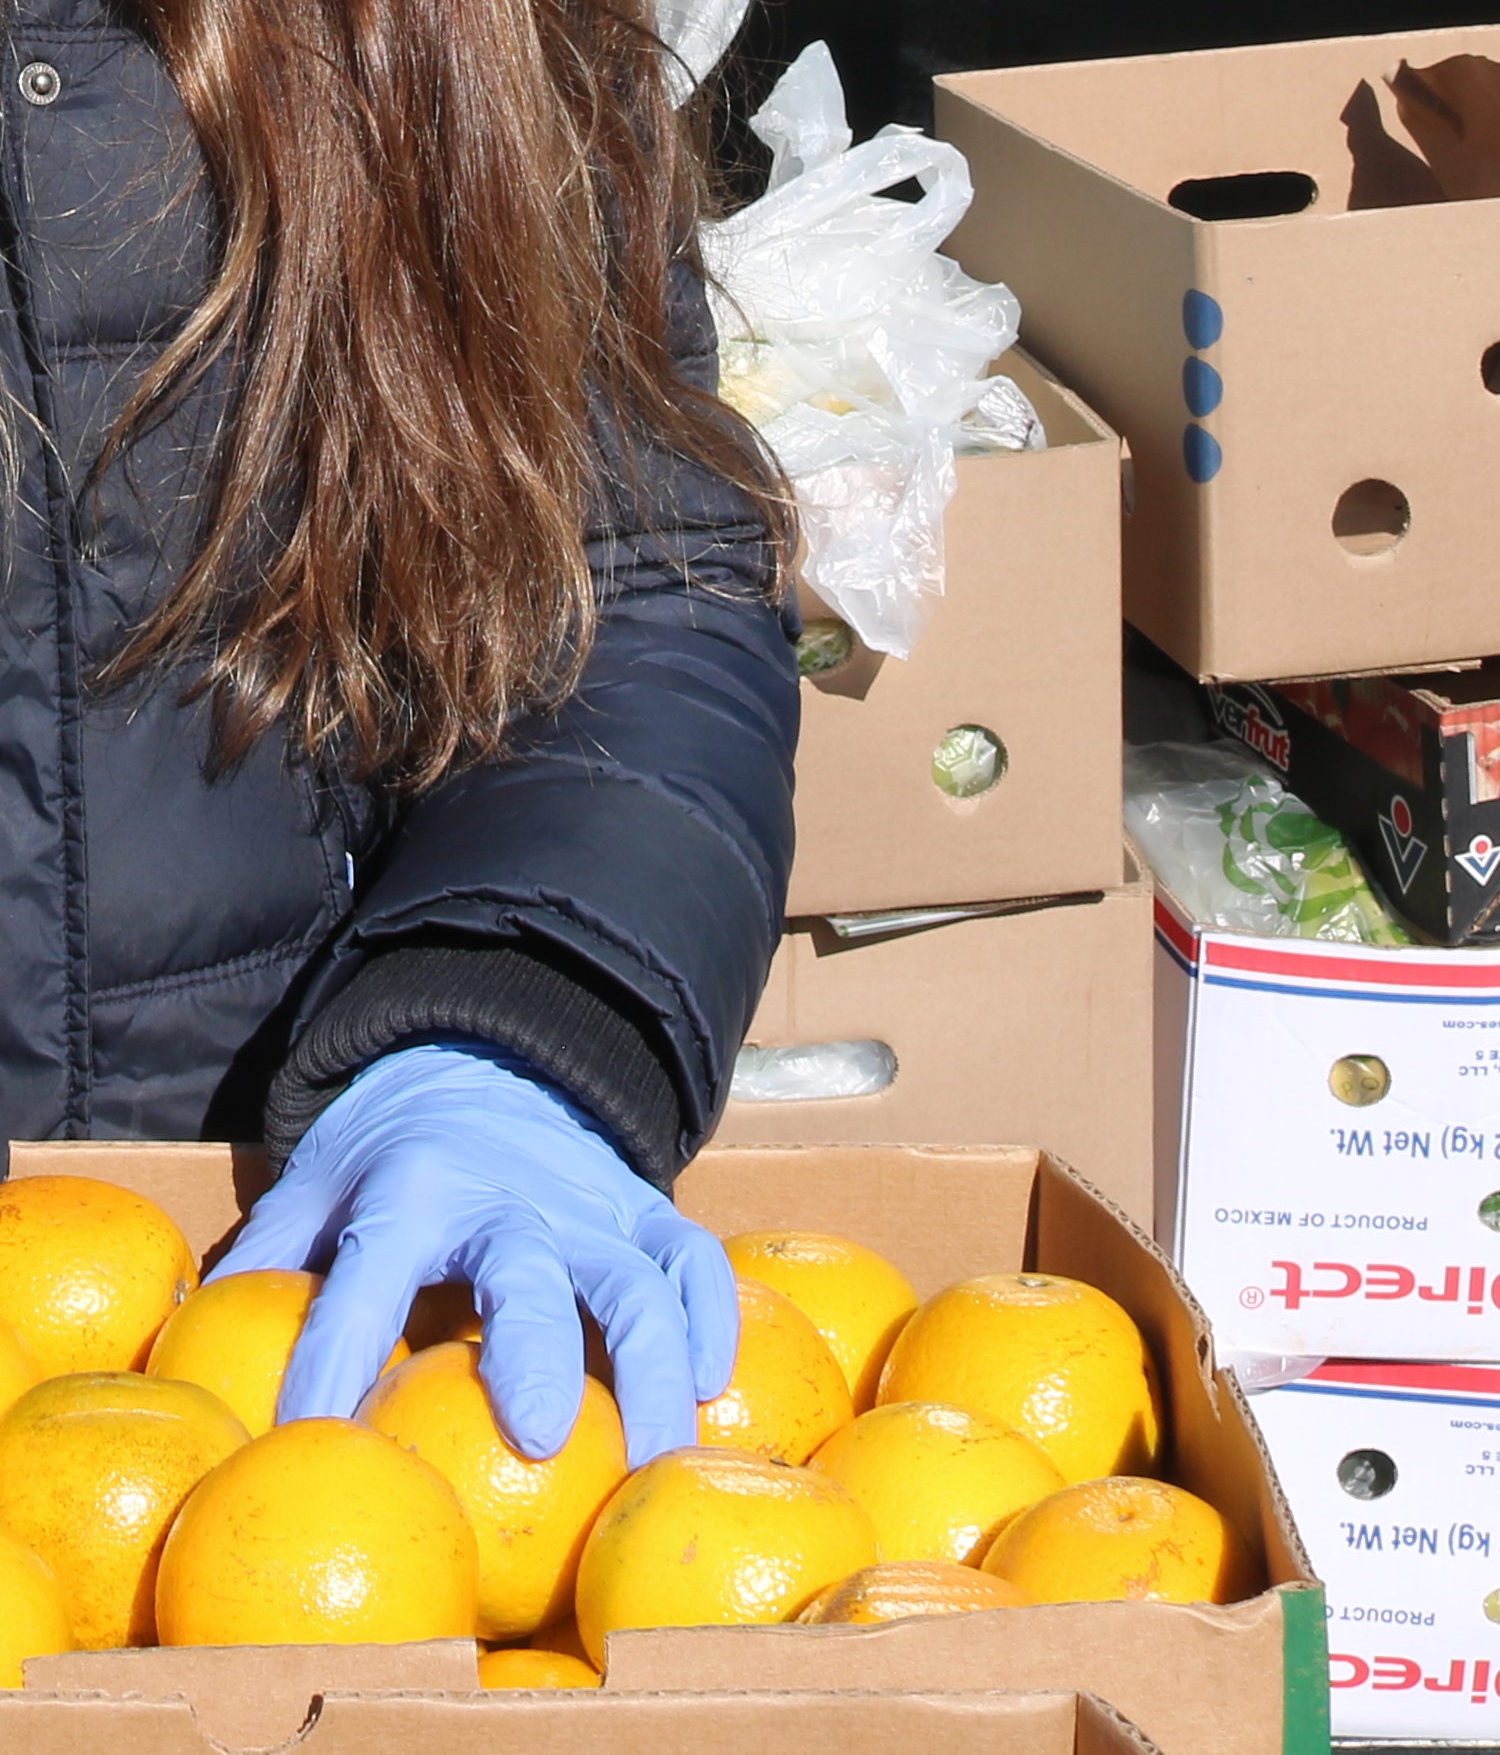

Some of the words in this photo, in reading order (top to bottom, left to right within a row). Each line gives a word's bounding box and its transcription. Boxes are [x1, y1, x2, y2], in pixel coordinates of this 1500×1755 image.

[1475, 1049, 1484, 1060] 5
[1458, 1065, 1488, 1076] LLC
[1330, 1127, 1375, 1157] Wt.
[1384, 1129, 1432, 1159] Net
[1441, 1125, 1485, 1160] kg)
[1214, 1207, 1293, 1226] MEXICO
[1298, 1212, 1326, 1228] OF
[1330, 1214, 1429, 1232] PRODUCT
[1481, 1450, 1491, 1461] 5
[1464, 1464, 1495, 1476] LLC
[1339, 1522, 1383, 1551] Wt.
[1391, 1525, 1439, 1555] Net
[1448, 1523, 1491, 1558] kg)
[1339, 1605, 1436, 1626] PRODUCT
